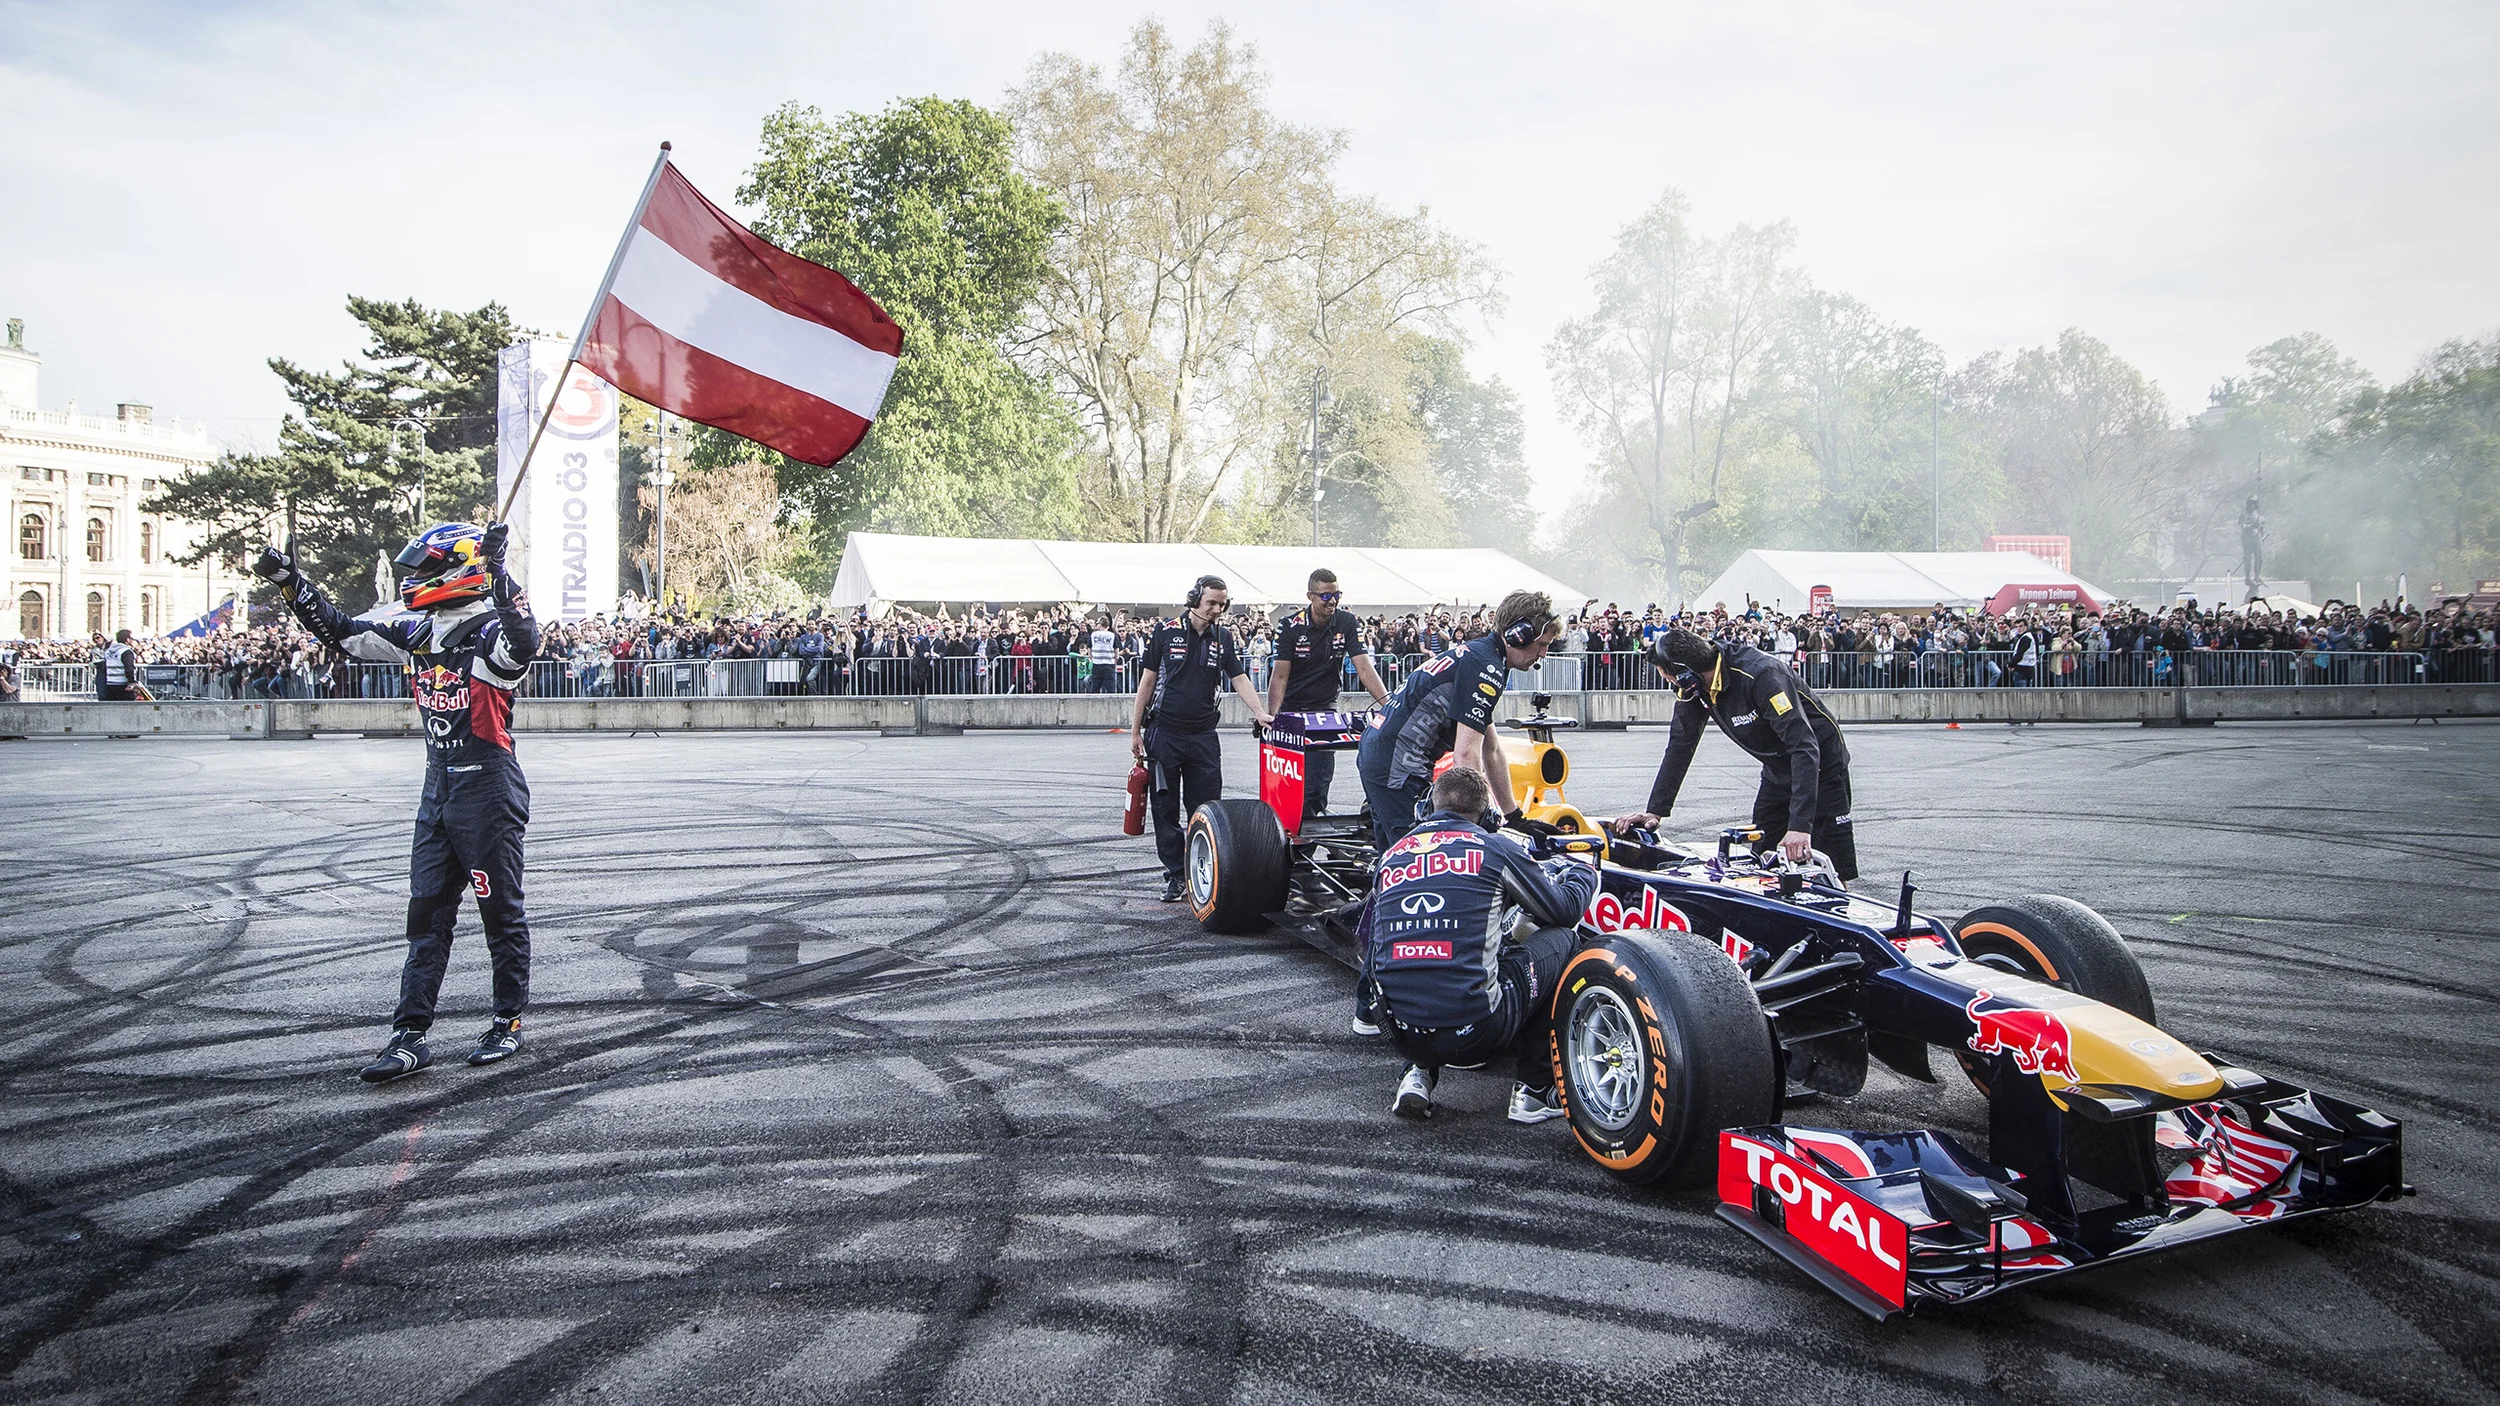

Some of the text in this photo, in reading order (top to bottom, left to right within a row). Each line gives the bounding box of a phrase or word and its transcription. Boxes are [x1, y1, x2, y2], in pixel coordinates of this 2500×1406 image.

[556, 452, 588, 492] Ö3
[2019, 588, 2077, 601] Kronen Zeitung
[1479, 671, 1503, 689] RENAULT
[1263, 748, 1303, 782] TOTAL
[471, 868, 491, 898] 3
[1380, 849, 1485, 894] Red Bull
[1389, 918, 1459, 932] INFINITI
[1395, 944, 1449, 957] TOTAL
[1614, 964, 1668, 1127] P ZERO
[1730, 1137, 1901, 1272] TOTAL
